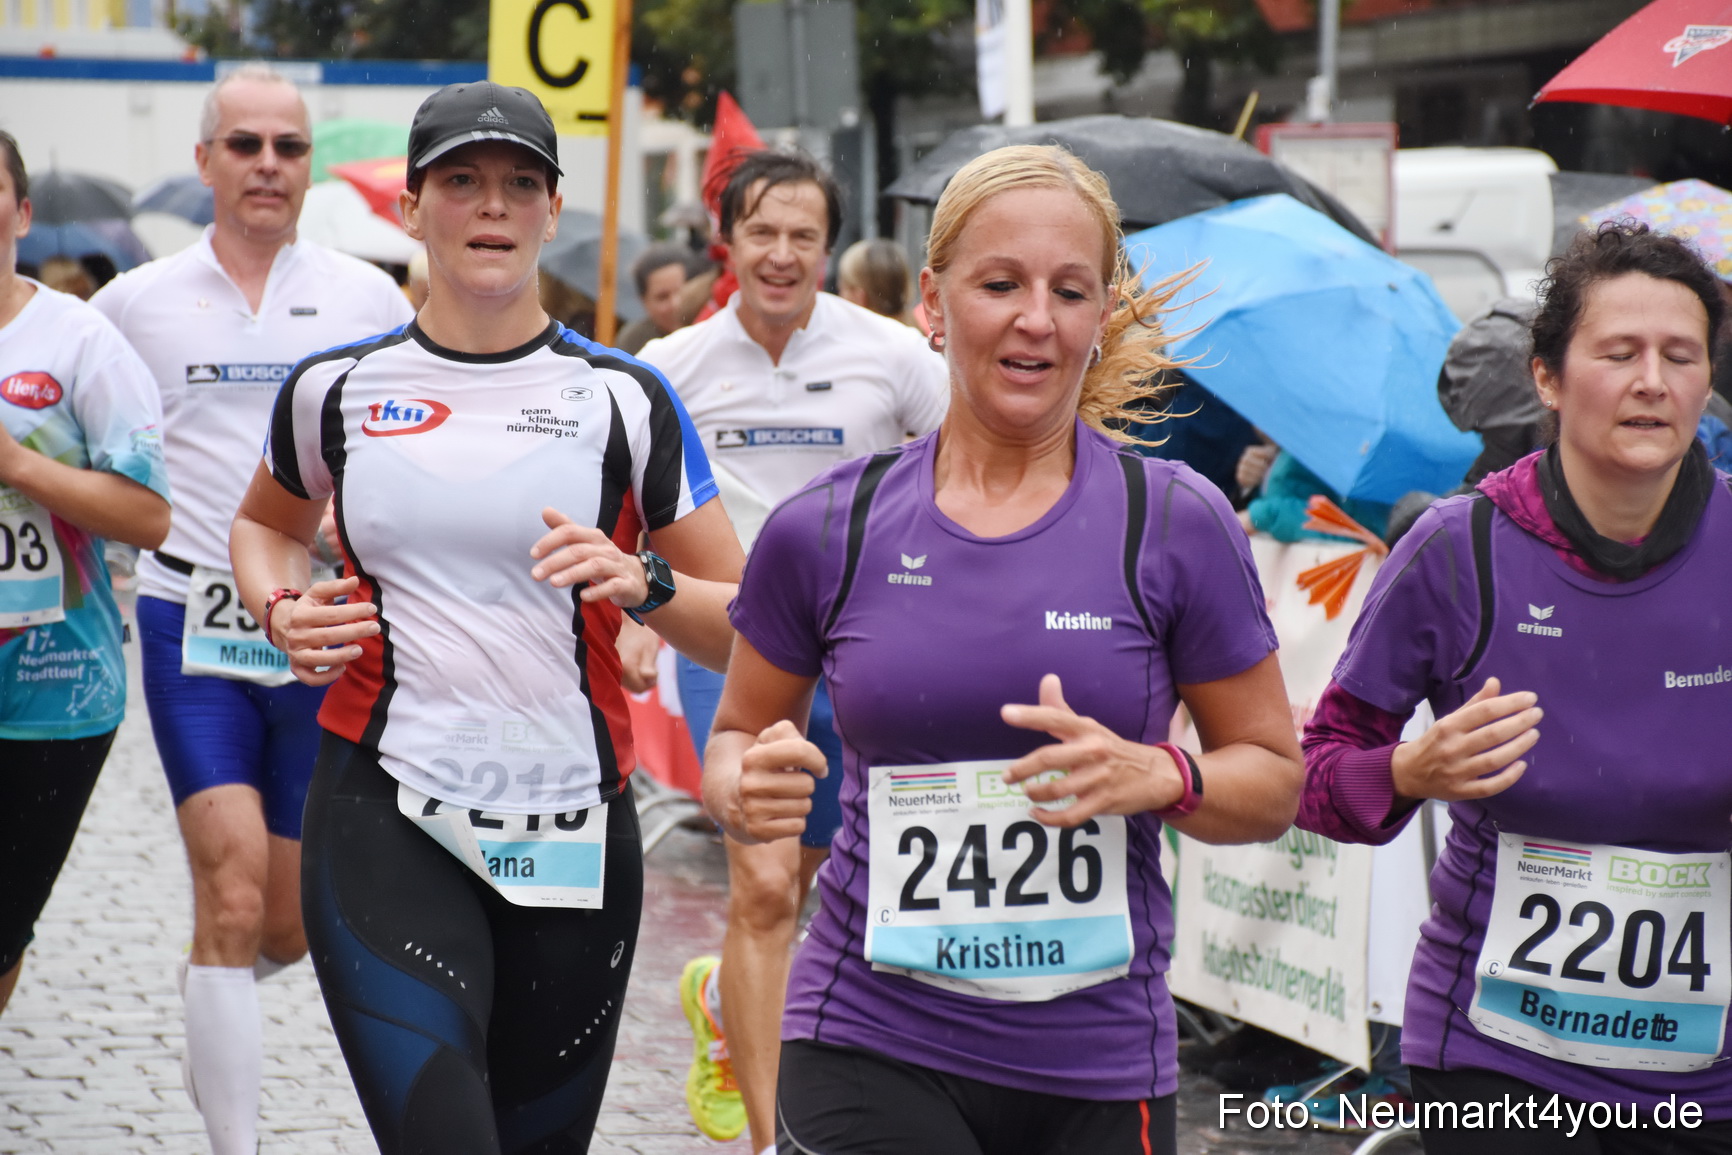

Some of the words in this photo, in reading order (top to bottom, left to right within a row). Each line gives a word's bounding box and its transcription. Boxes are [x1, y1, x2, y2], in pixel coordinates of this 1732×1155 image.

[528, 0, 590, 88] C
[477, 116, 509, 124] adidas
[227, 365, 293, 381] BÜSC
[368, 400, 425, 422] tkn
[521, 408, 551, 416] team
[506, 422, 563, 438] nürnberg
[564, 430, 579, 438] e.V.
[528, 415, 579, 428] klinikum
[887, 572, 932, 586] erima
[1045, 611, 1112, 630] Kristina
[1517, 622, 1563, 637] erima
[26, 629, 56, 653] 17.
[16, 663, 86, 683] Stadtlauf
[1664, 664, 1732, 689] Bernade
[888, 793, 962, 808] NeuerMarkt
[482, 851, 535, 878] ana
[898, 819, 1103, 912] 2426
[1517, 860, 1593, 882] NeuerMarkt
[1608, 855, 1712, 889] BOCK
[1606, 883, 1643, 896] inspired
[1645, 888, 1657, 898] by
[1658, 890, 1679, 898] smart
[1680, 890, 1712, 898] concepts
[880, 909, 890, 923] C
[1508, 893, 1712, 992] 2204
[936, 935, 1066, 970] Kristina
[1488, 962, 1499, 976] C
[1520, 989, 1679, 1043] Bernadette
